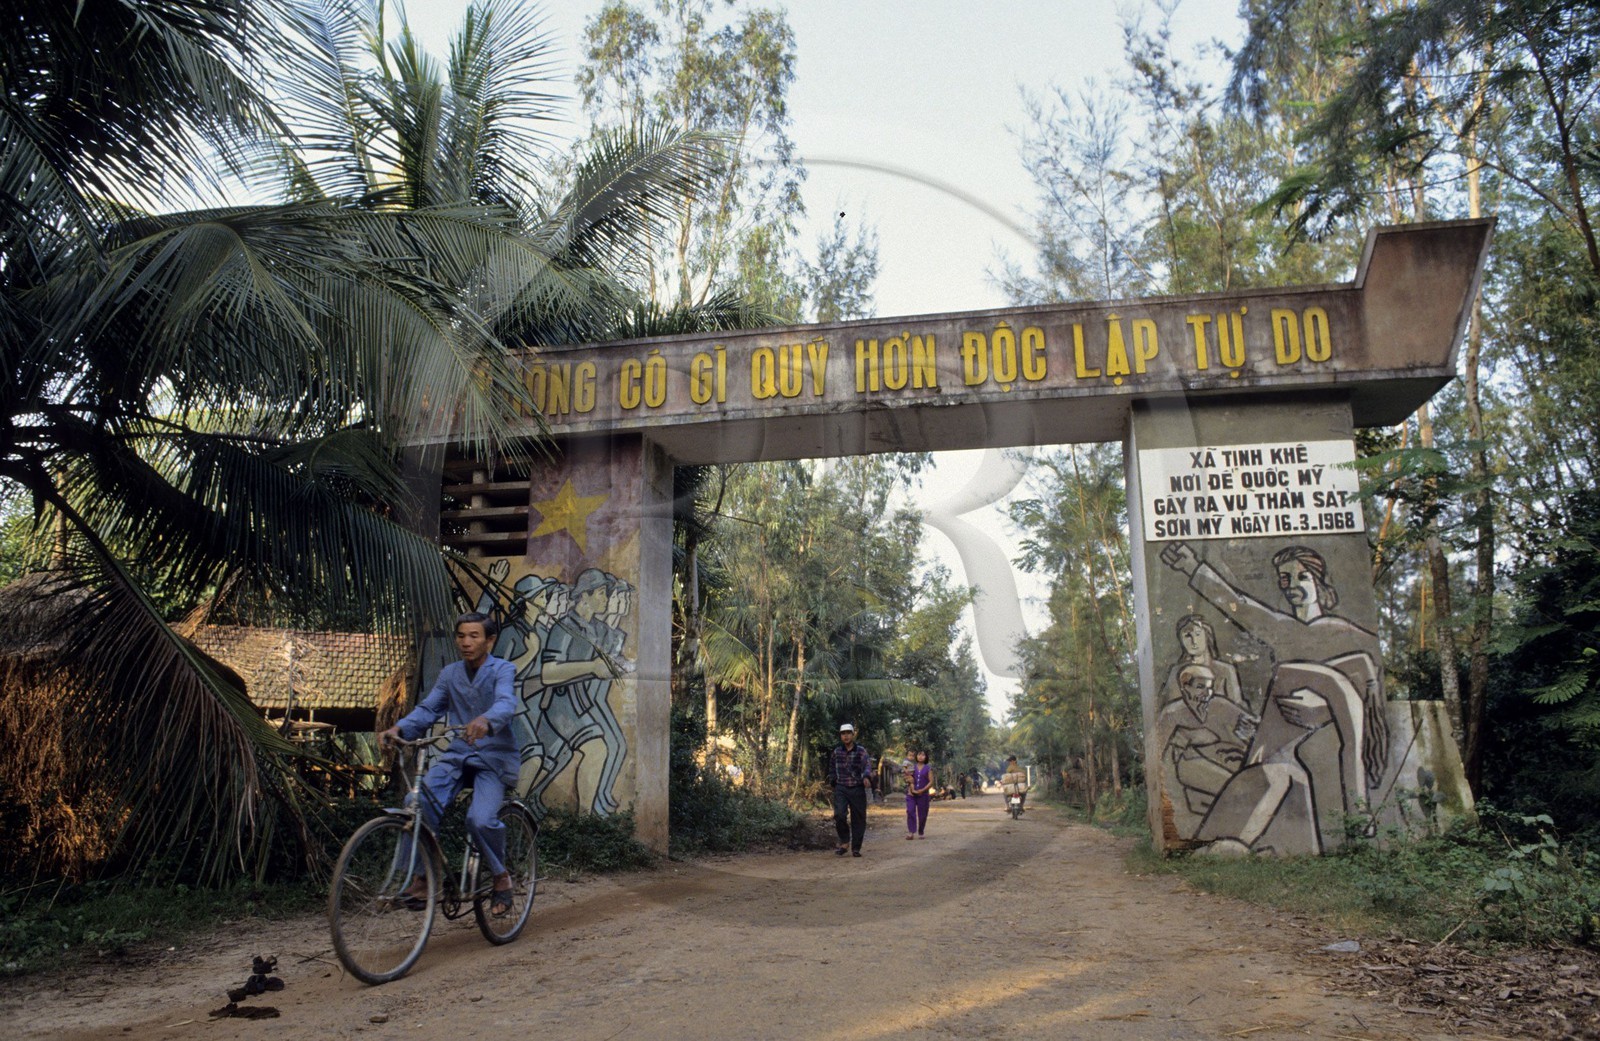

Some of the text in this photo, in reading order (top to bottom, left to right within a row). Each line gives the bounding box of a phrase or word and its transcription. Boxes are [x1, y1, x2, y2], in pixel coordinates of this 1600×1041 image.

[620, 349, 667, 410] CÓ
[690, 344, 727, 405] GÌ
[751, 335, 829, 400] QUÝ
[855, 330, 937, 393] HƠN
[960, 320, 1048, 393] ĐỘC
[1072, 312, 1160, 387] LẬP
[1186, 306, 1249, 379] TỰ
[1271, 306, 1333, 366] DO
[1189, 447, 1216, 468] XÃ
[1269, 443, 1308, 465] KHÊ
[1169, 473, 1202, 493] NƠI
[1241, 466, 1290, 491] QUỐC
[1297, 464, 1326, 486] MỸ
[1153, 494, 1188, 516] GÂY
[1193, 496, 1219, 513] RA
[1222, 494, 1248, 516] VỤ
[1312, 484, 1348, 508] SÁT
[1154, 518, 1192, 538] SƠN
[1197, 514, 1225, 535] MỸ
